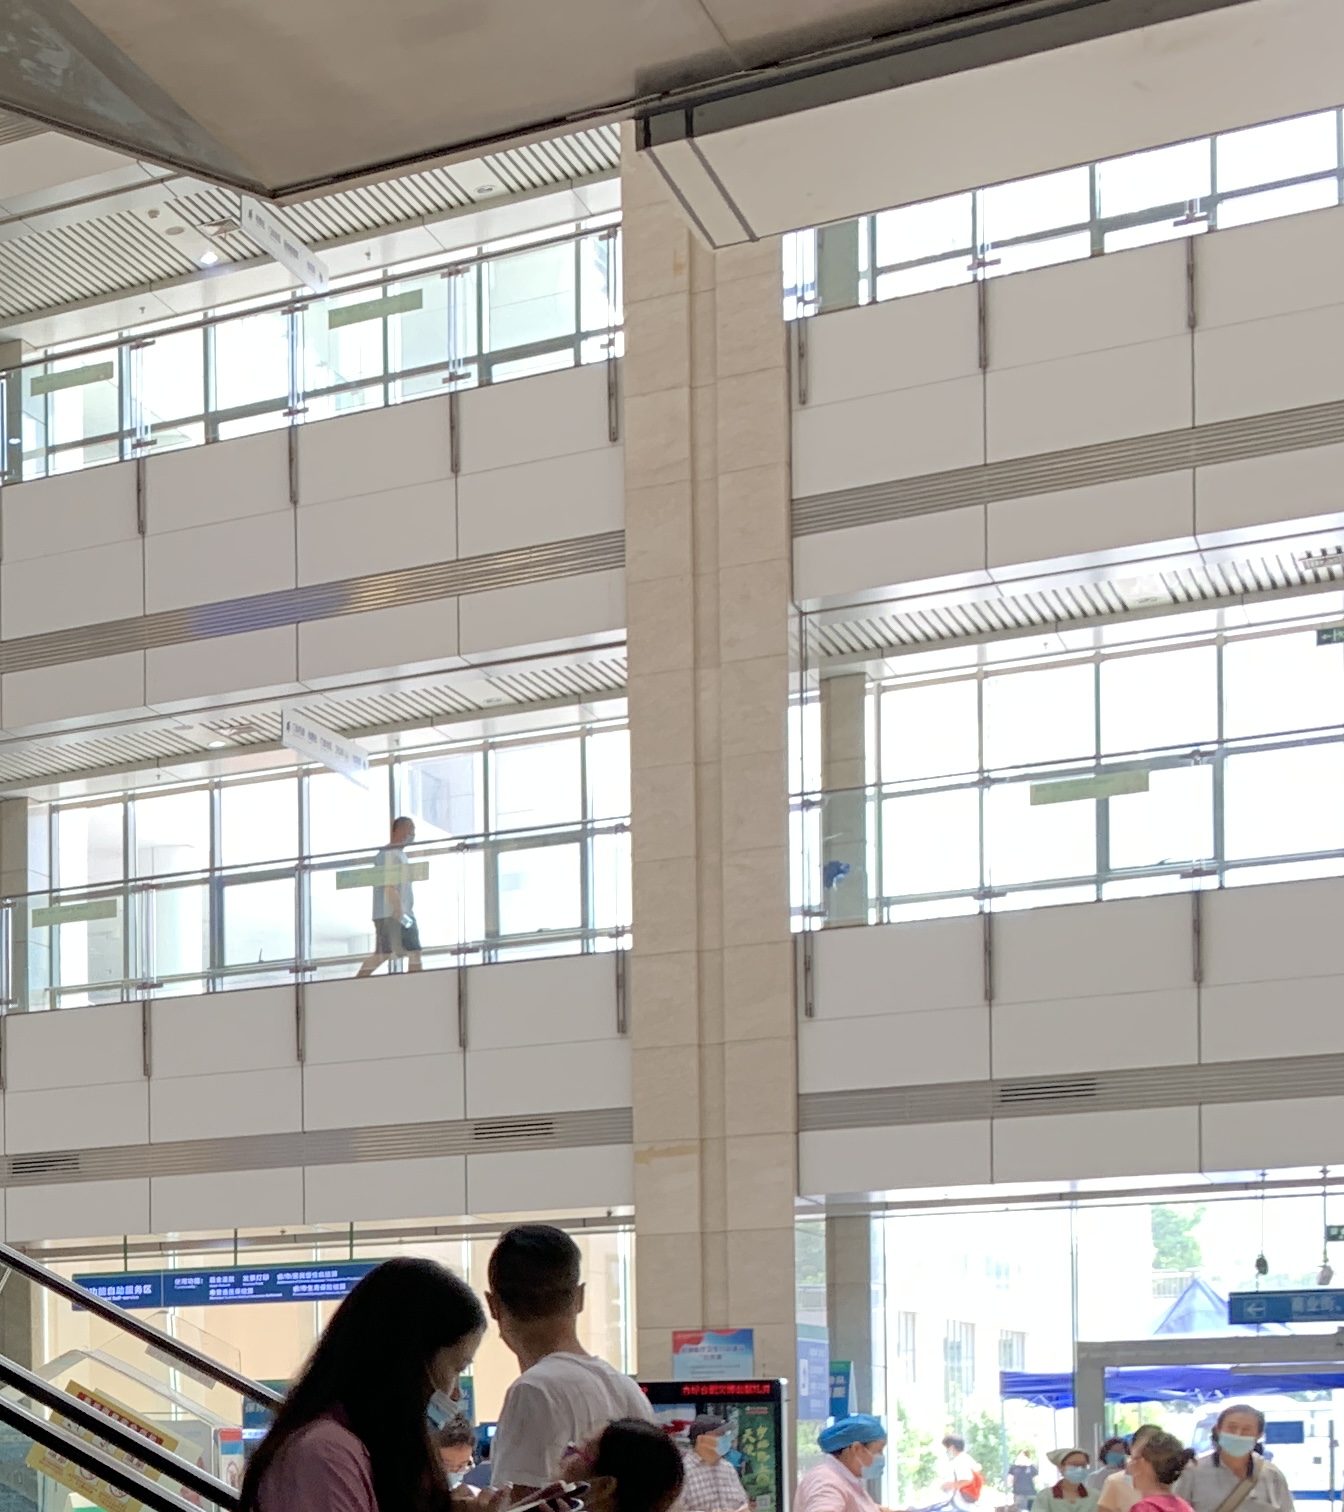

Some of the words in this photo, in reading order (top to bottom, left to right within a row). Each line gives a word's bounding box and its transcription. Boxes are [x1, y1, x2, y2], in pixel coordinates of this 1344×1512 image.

[85, 1284, 153, 1296] 功能自助服务区
